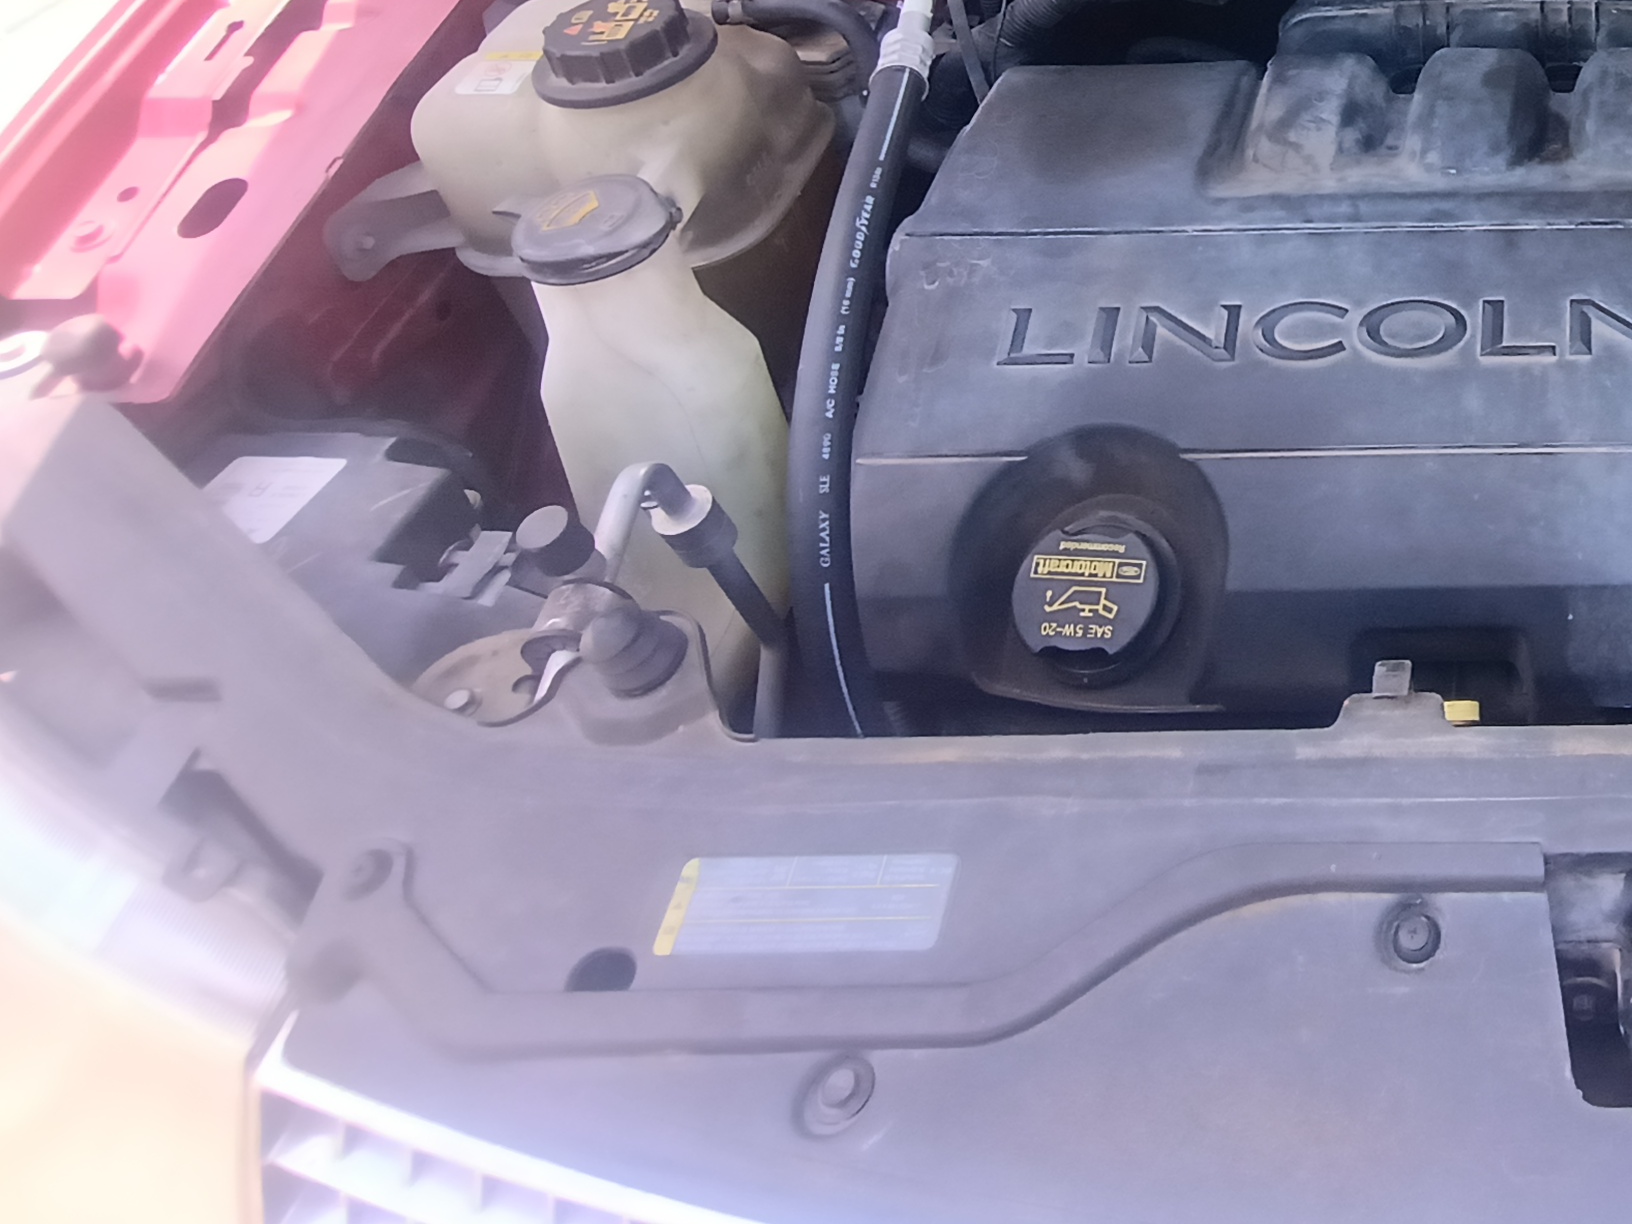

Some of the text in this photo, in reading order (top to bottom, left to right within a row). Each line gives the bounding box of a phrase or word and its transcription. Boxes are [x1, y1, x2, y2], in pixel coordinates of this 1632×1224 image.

[850, 195, 875, 268] GOODYEAR
[828, 363, 840, 393] HOSE
[825, 398, 836, 418] A/C
[819, 475, 830, 494] SLE
[818, 510, 831, 567] GALAXY
[1059, 541, 1126, 553] Recommended
[1037, 558, 1114, 577] Motorcraft
[1041, 622, 1113, 639] SAE 5W-20
